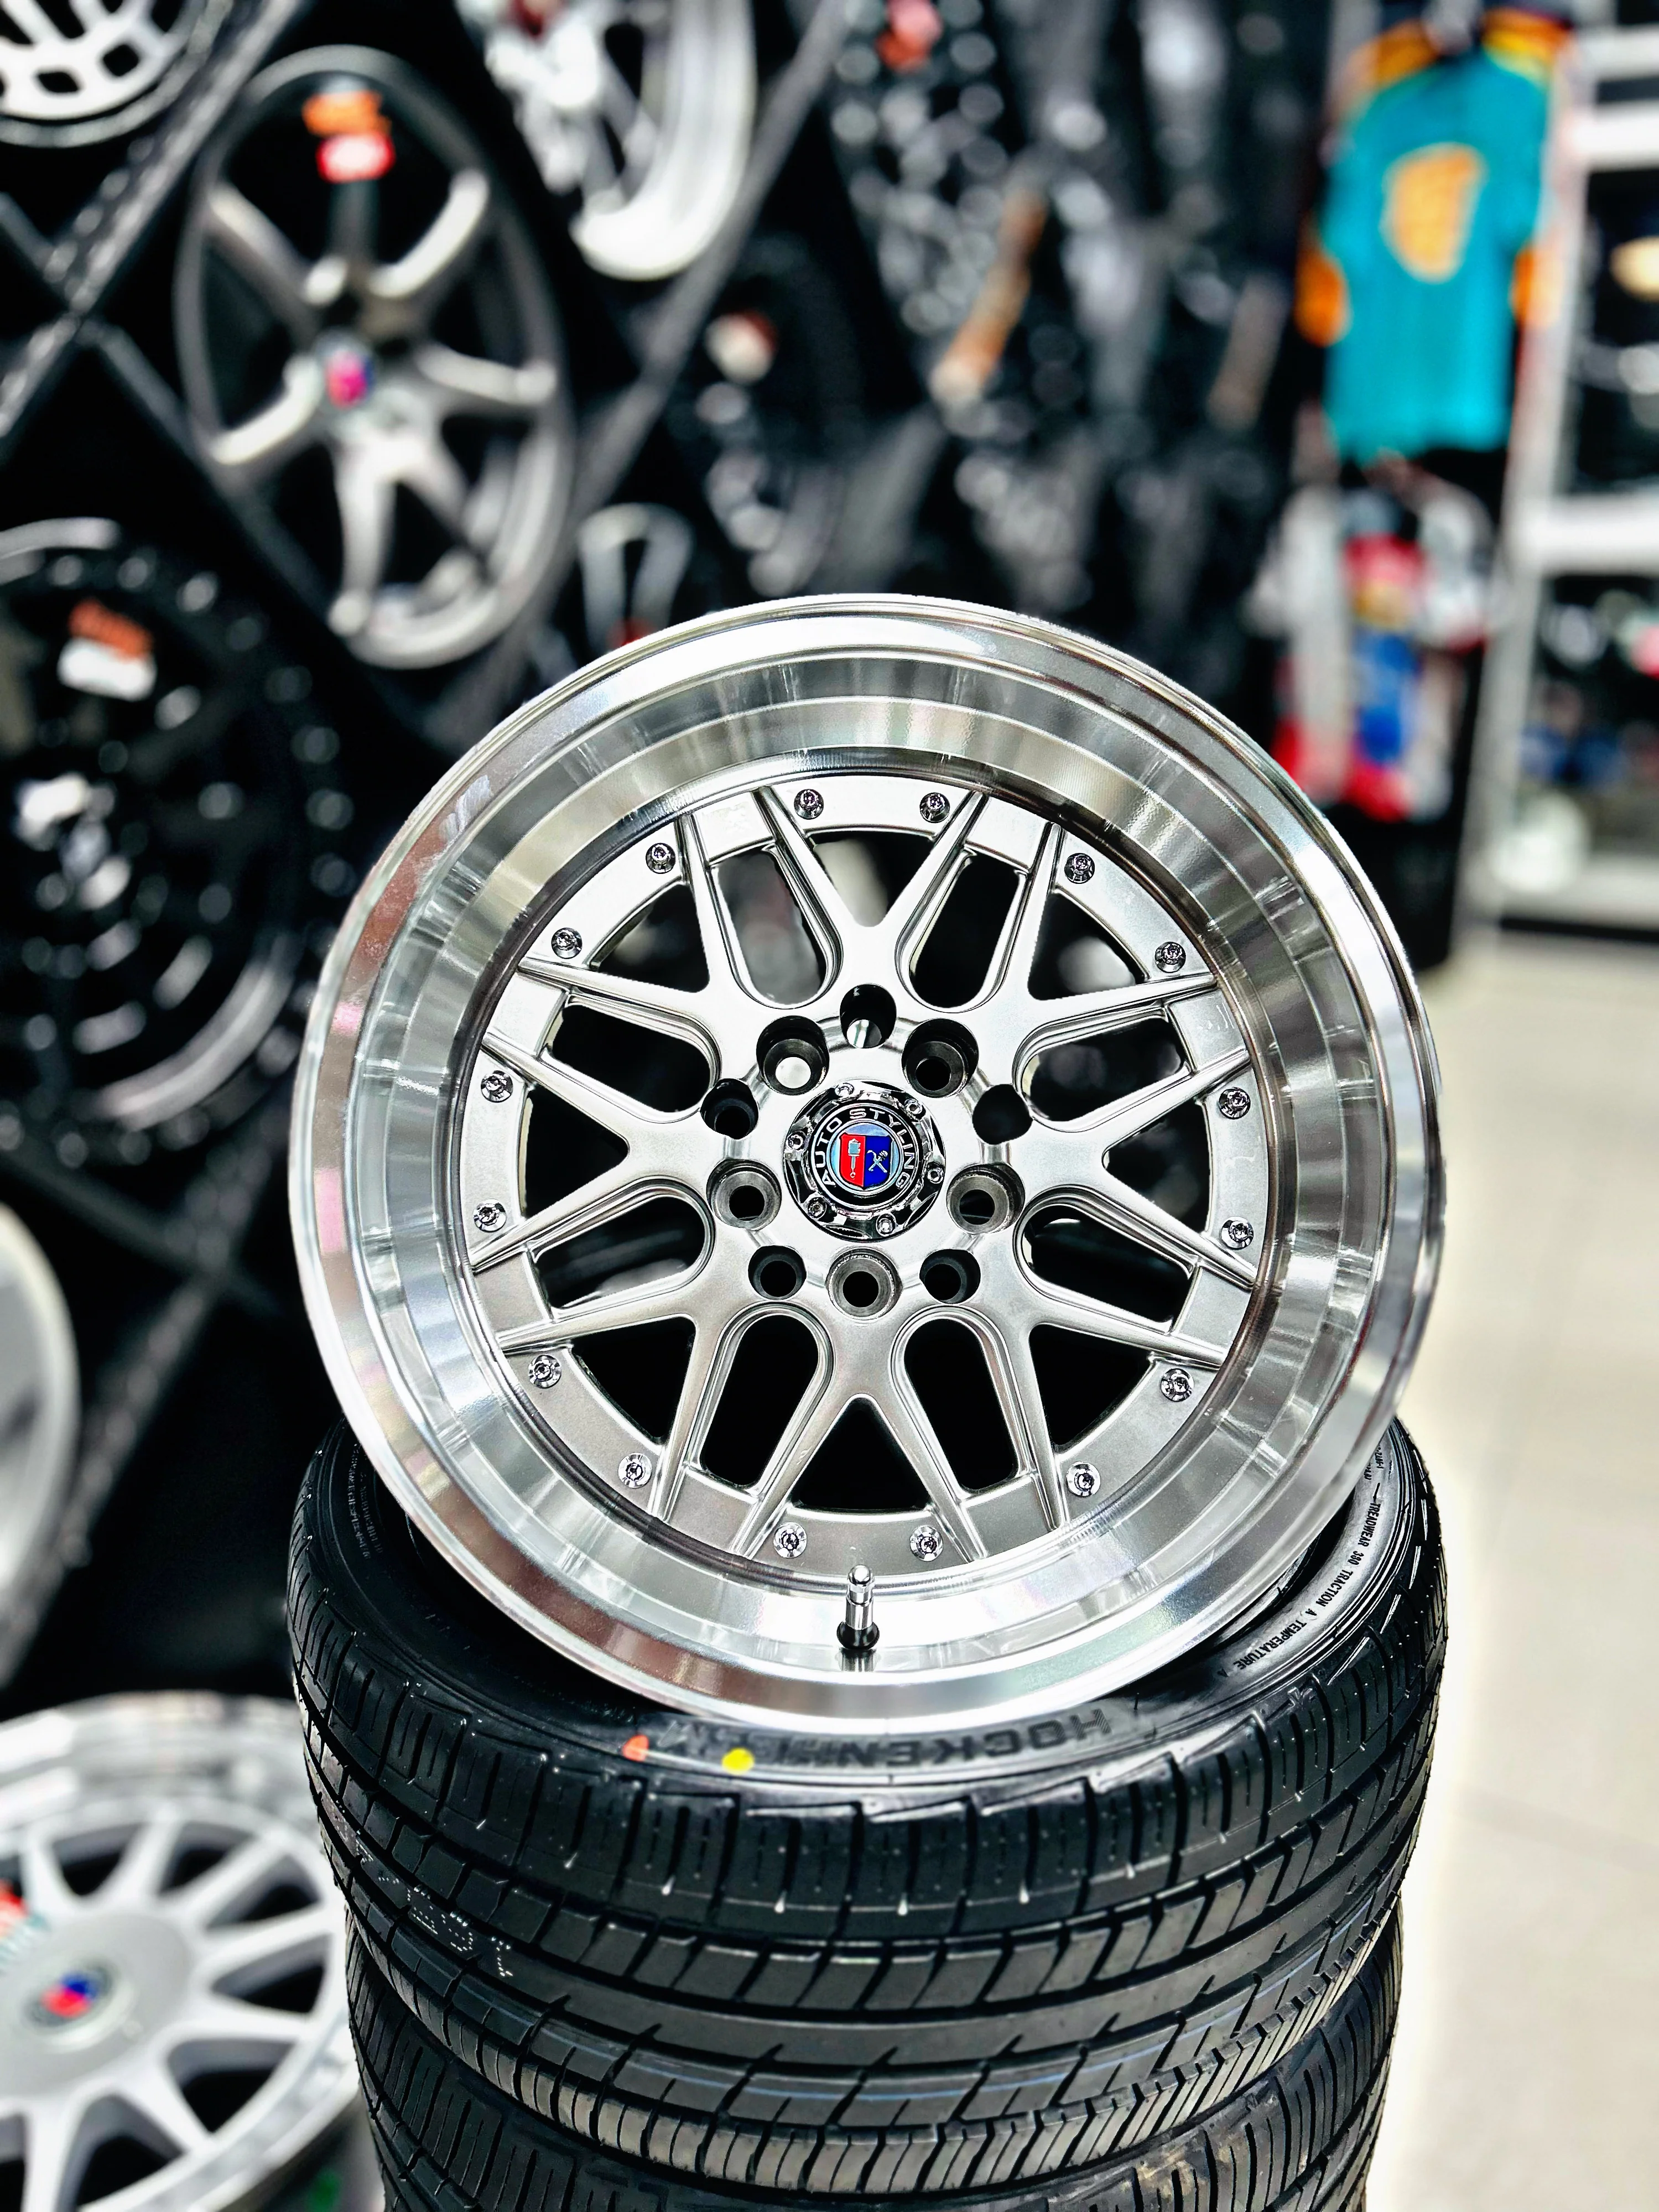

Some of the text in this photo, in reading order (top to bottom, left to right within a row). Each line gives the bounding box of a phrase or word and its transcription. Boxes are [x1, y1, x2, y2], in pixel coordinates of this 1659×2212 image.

[814, 1107, 915, 1189] AUTO STYLING
[1357, 1502, 1381, 1547] TREADWEAR
[1316, 1569, 1354, 1607] TRACTION
[1304, 1608, 1317, 1616] A
[1233, 1621, 1307, 1670] TEMPERATURE
